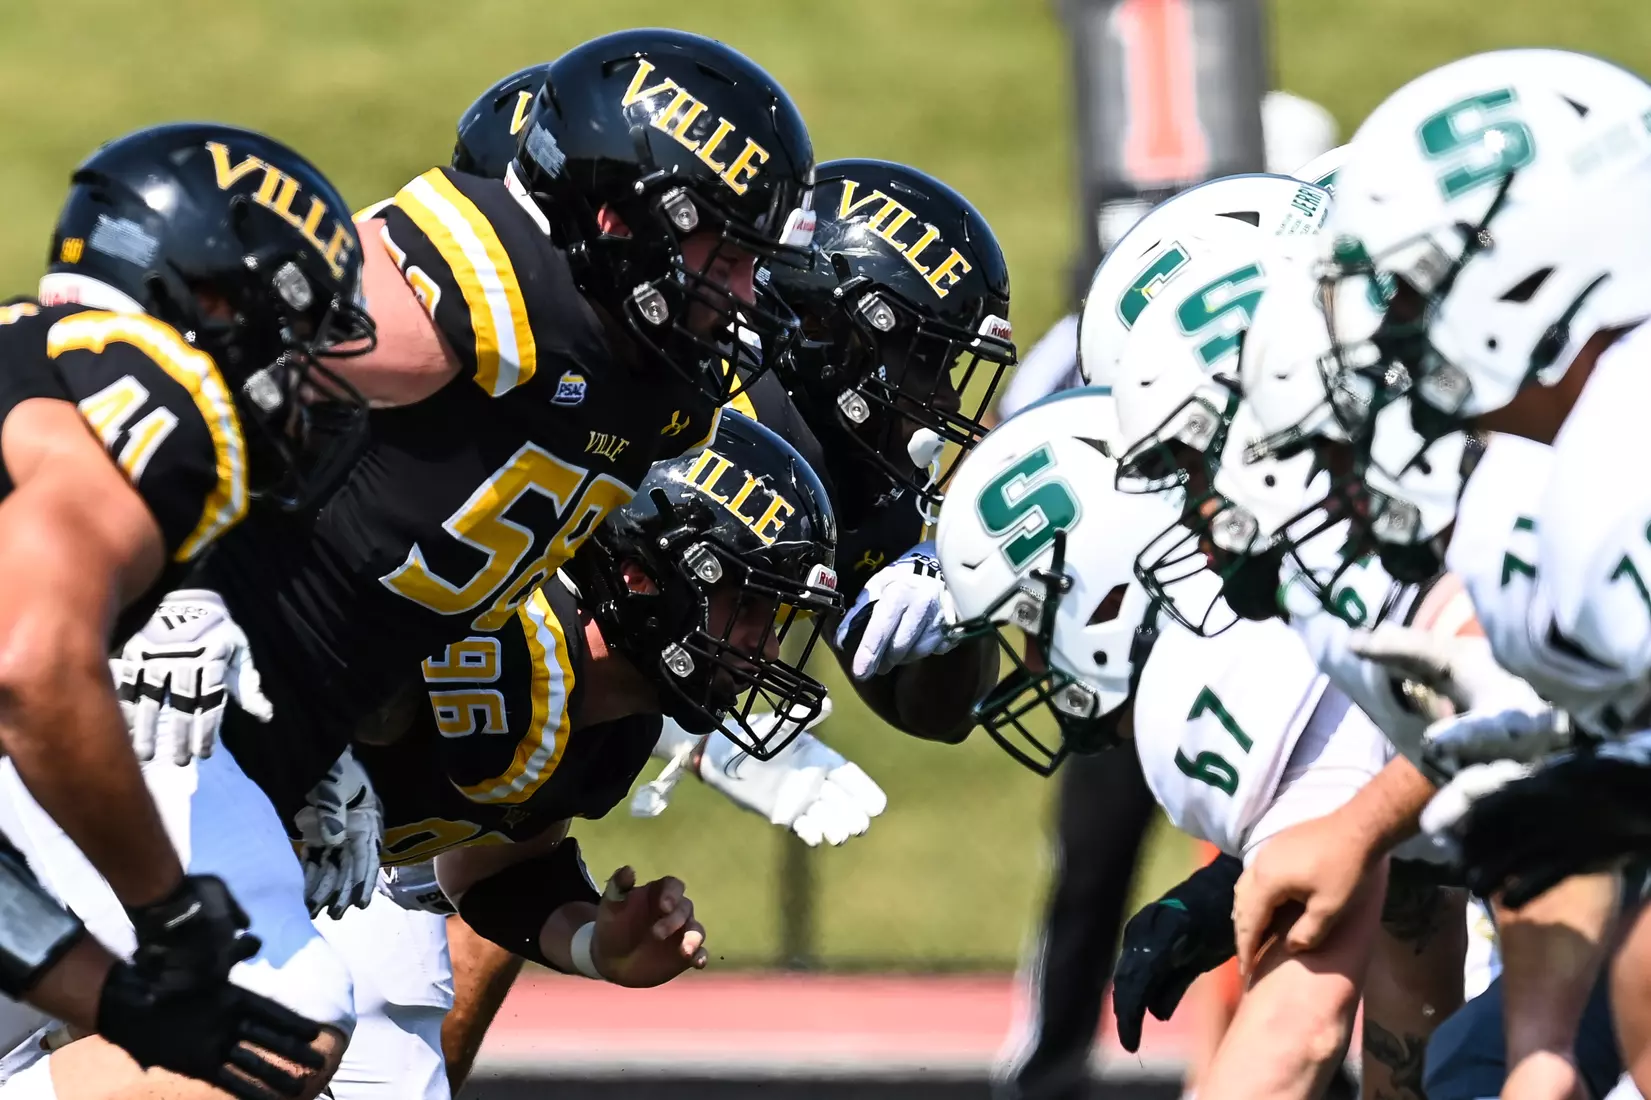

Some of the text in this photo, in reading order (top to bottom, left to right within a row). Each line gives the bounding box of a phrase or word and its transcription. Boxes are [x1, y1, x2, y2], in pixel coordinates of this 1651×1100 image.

[621, 57, 770, 196] VILLE
[1414, 86, 1536, 200] S
[205, 141, 354, 281] VILLE
[835, 178, 972, 299] VILLE
[77, 374, 179, 488] 41
[560, 382, 585, 396] PSAC
[584, 430, 630, 463] VILLE
[684, 448, 795, 547] ILLE
[378, 440, 637, 632] 58
[976, 441, 1082, 573] S
[420, 635, 508, 739] 96
[1173, 685, 1254, 797] 67
